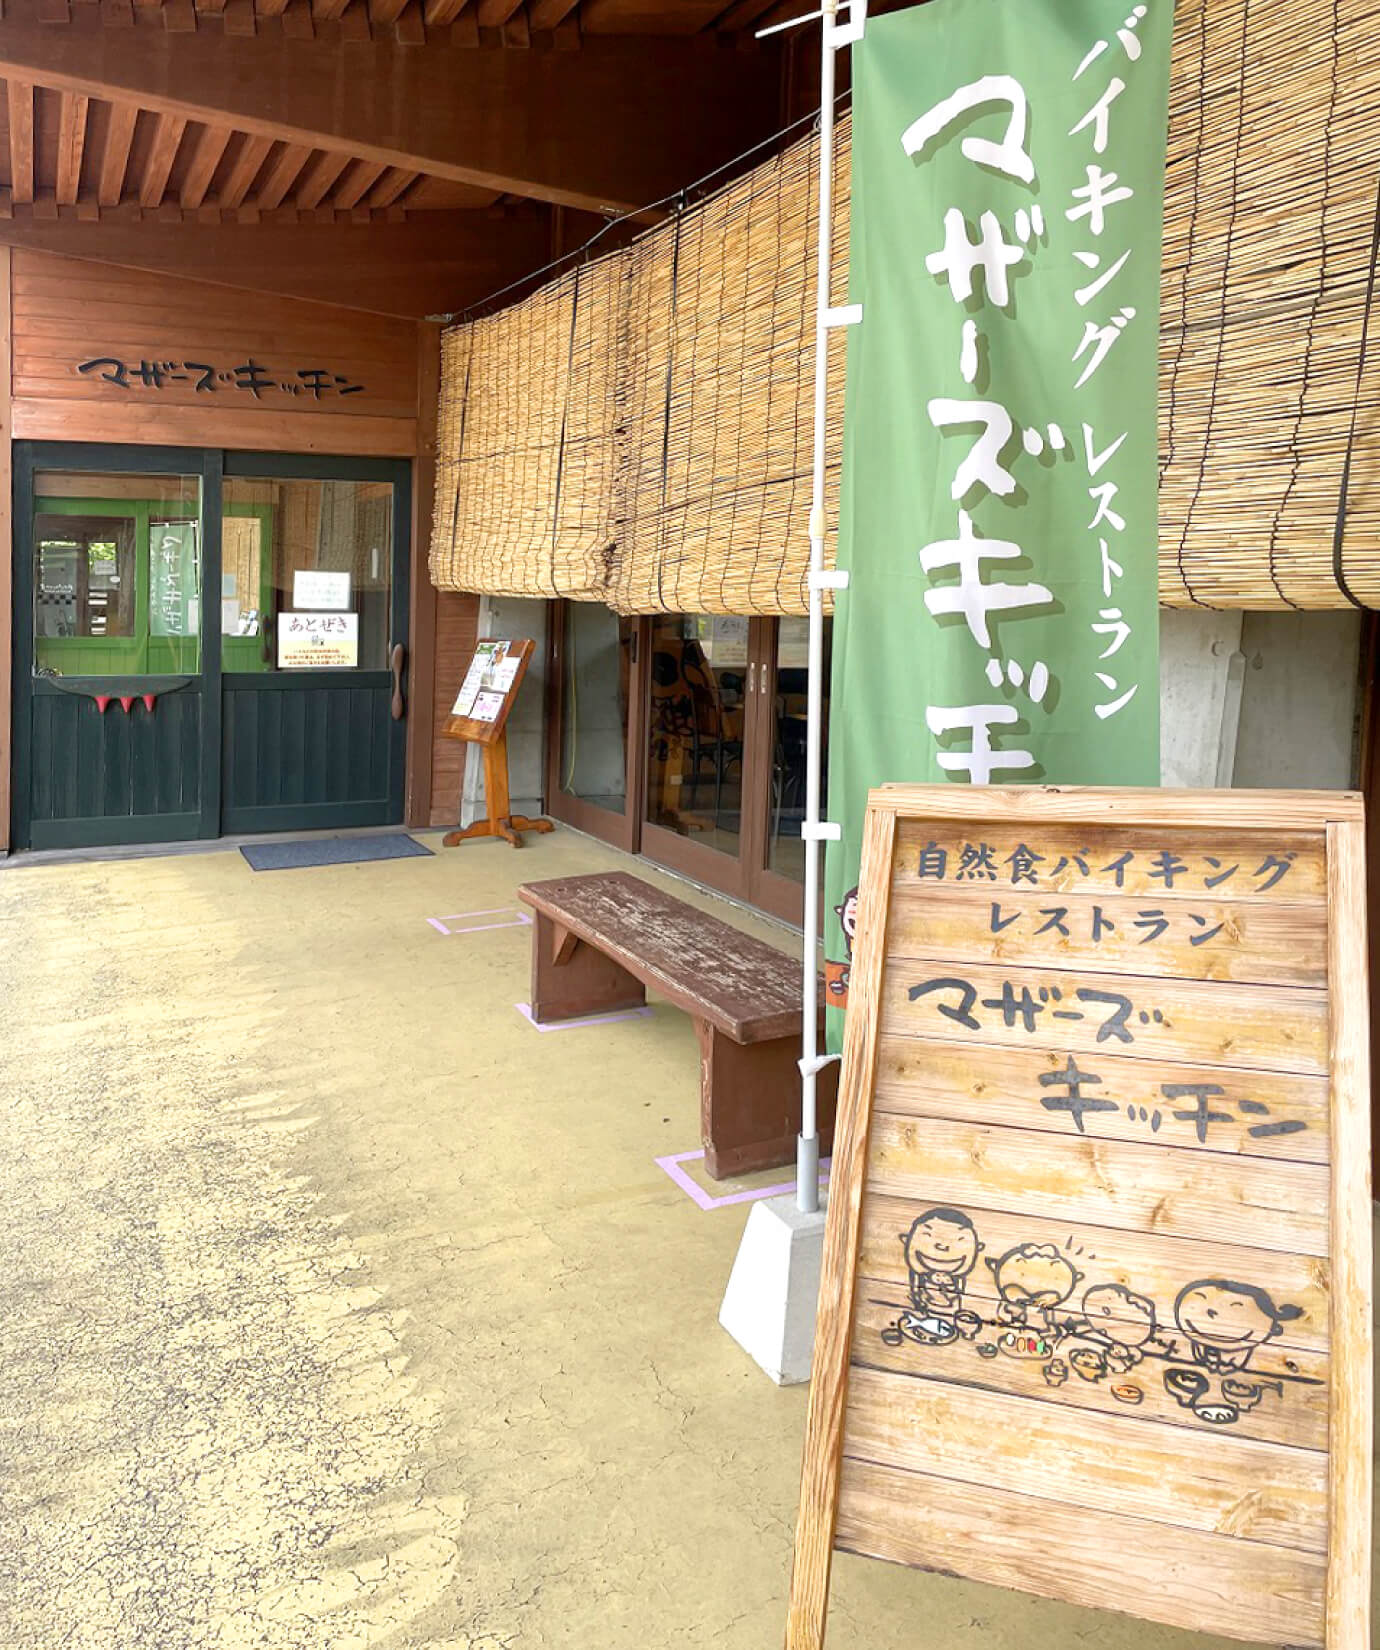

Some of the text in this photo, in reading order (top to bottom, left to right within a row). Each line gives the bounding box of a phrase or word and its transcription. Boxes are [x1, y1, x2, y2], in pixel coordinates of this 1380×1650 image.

[78, 357, 365, 400] マザーズキッチン
[1065, 4, 1148, 720] バイキング レストラン
[288, 616, 348, 633] あとぜき
[917, 841, 1298, 893] 自然食バイキング
[990, 902, 1226, 946] レストラン
[908, 977, 1165, 1044] マザーズ
[1037, 1053, 1308, 1144] キッチン
